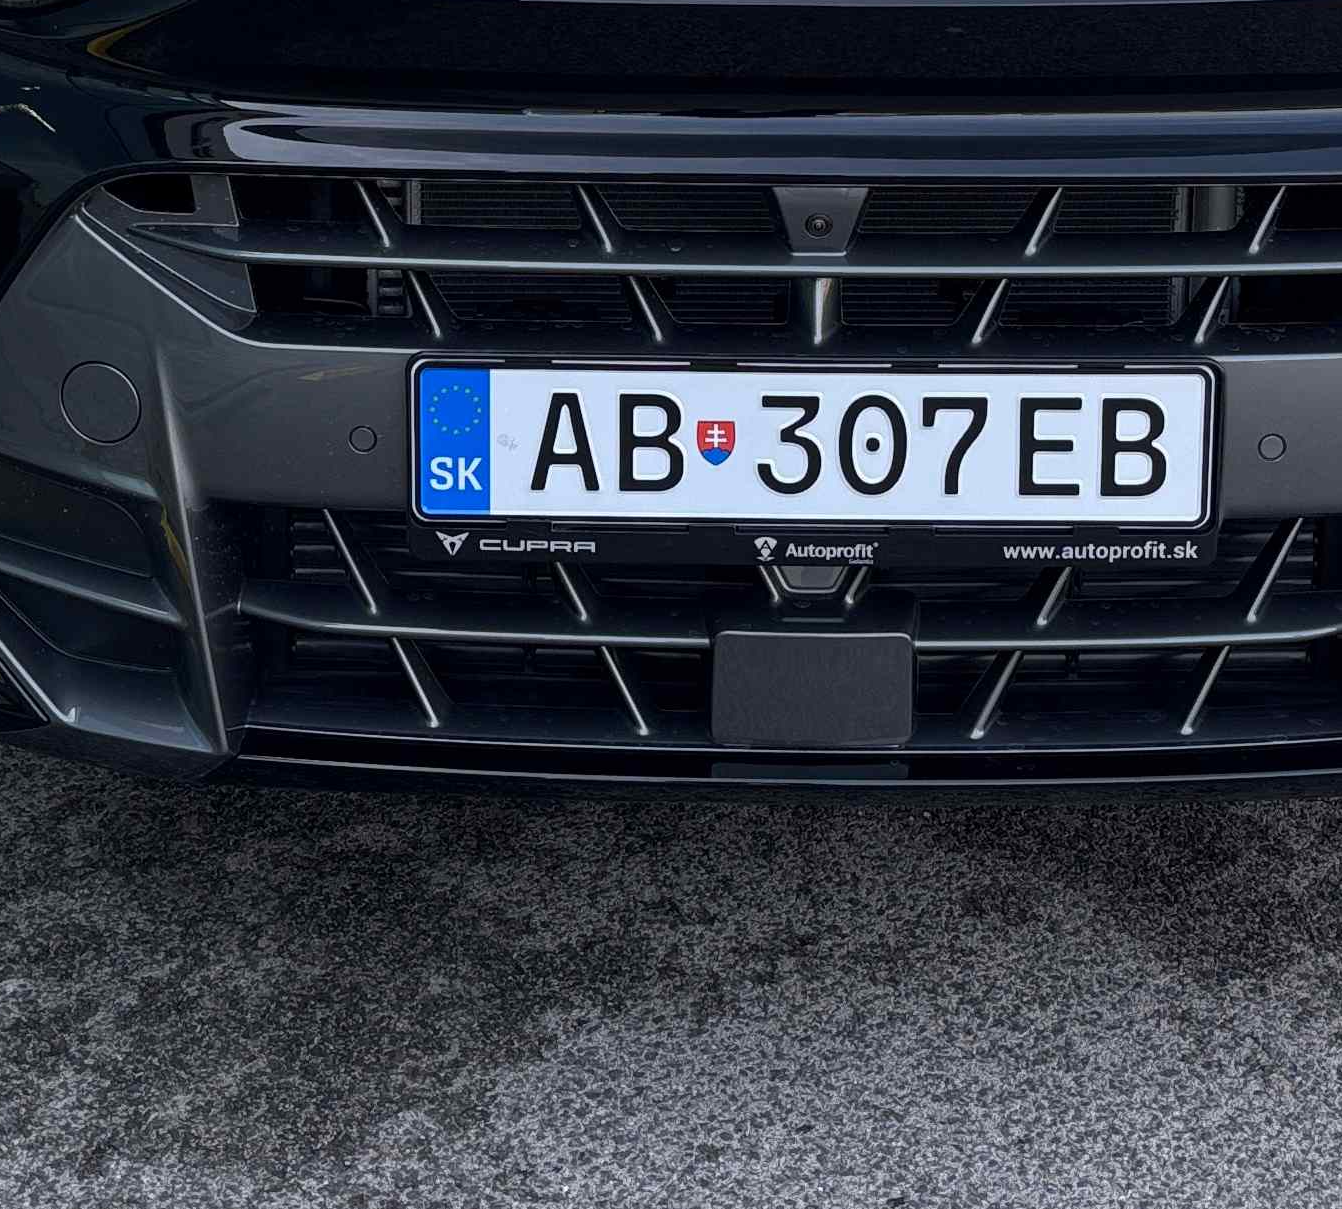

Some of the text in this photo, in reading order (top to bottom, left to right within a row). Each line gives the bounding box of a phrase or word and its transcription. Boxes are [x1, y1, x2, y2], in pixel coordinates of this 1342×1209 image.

[529, 392, 1168, 497] AB 307EB
[429, 455, 483, 491] SK
[478, 538, 597, 554] CUPRA
[784, 542, 875, 561] Autoprofit
[1002, 540, 1199, 565] www.autoprofit.sk
